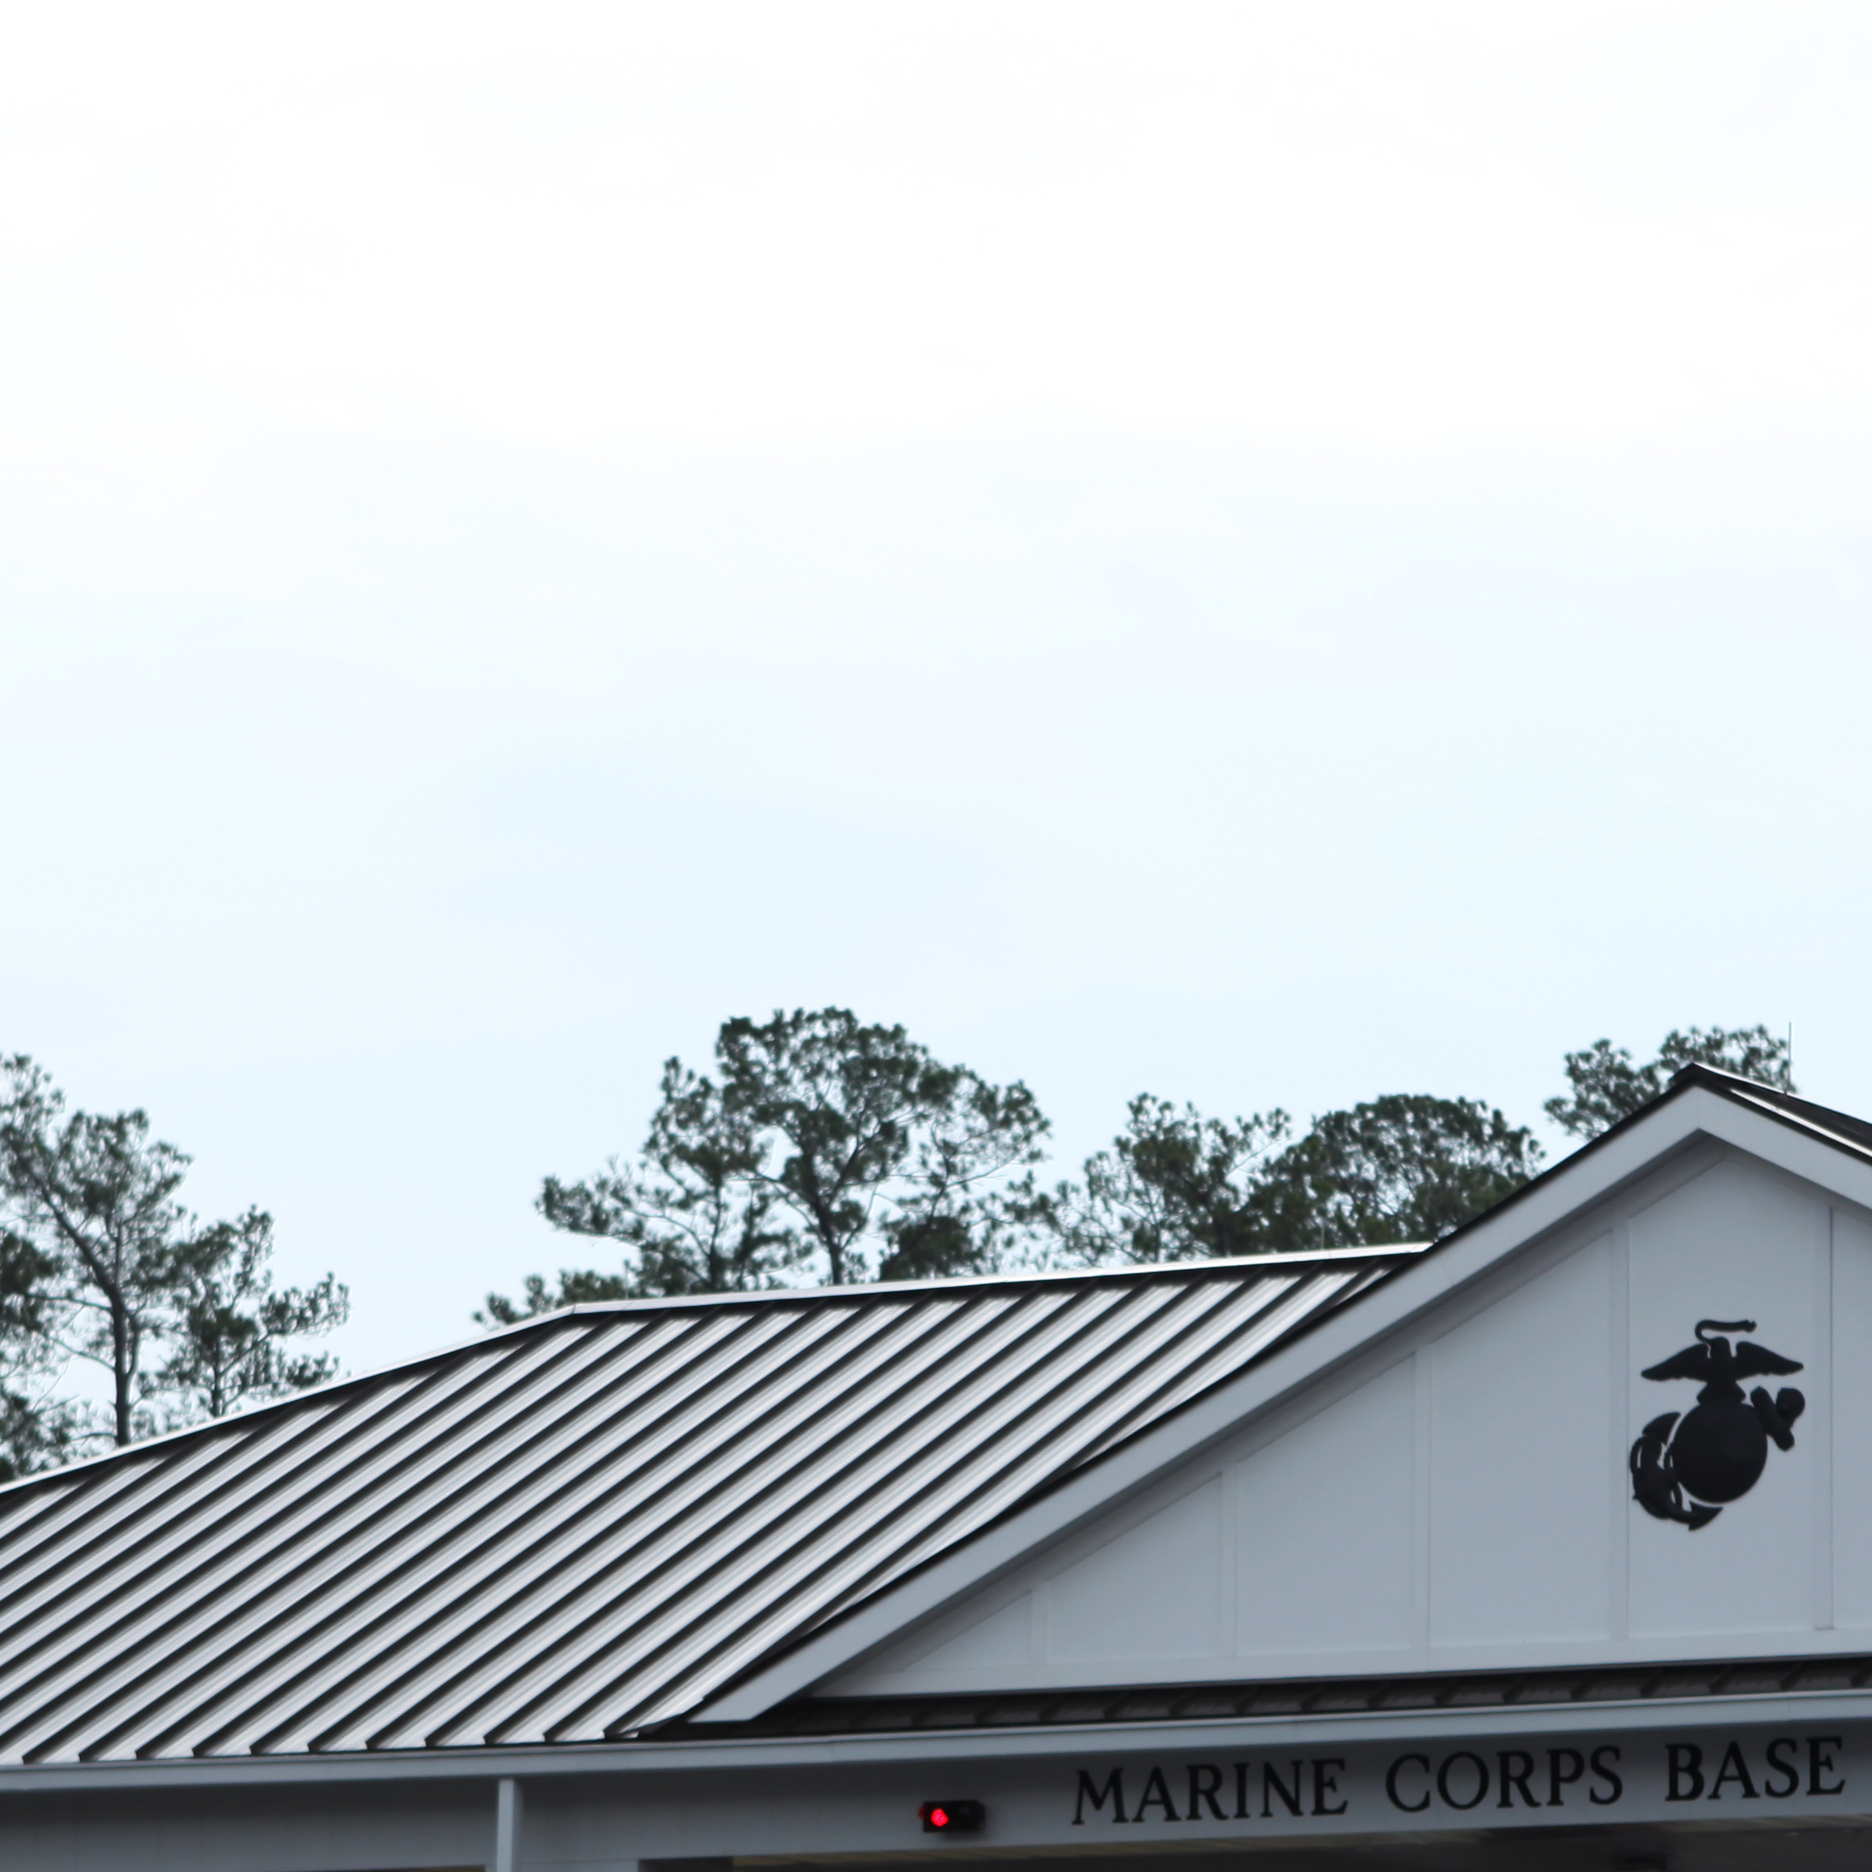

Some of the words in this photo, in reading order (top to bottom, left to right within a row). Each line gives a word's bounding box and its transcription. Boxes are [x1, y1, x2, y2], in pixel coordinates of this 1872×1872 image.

[1071, 1758, 1349, 1826] MARINE
[1385, 1744, 1624, 1813] CORPS
[1663, 1734, 1846, 1801] BASE
